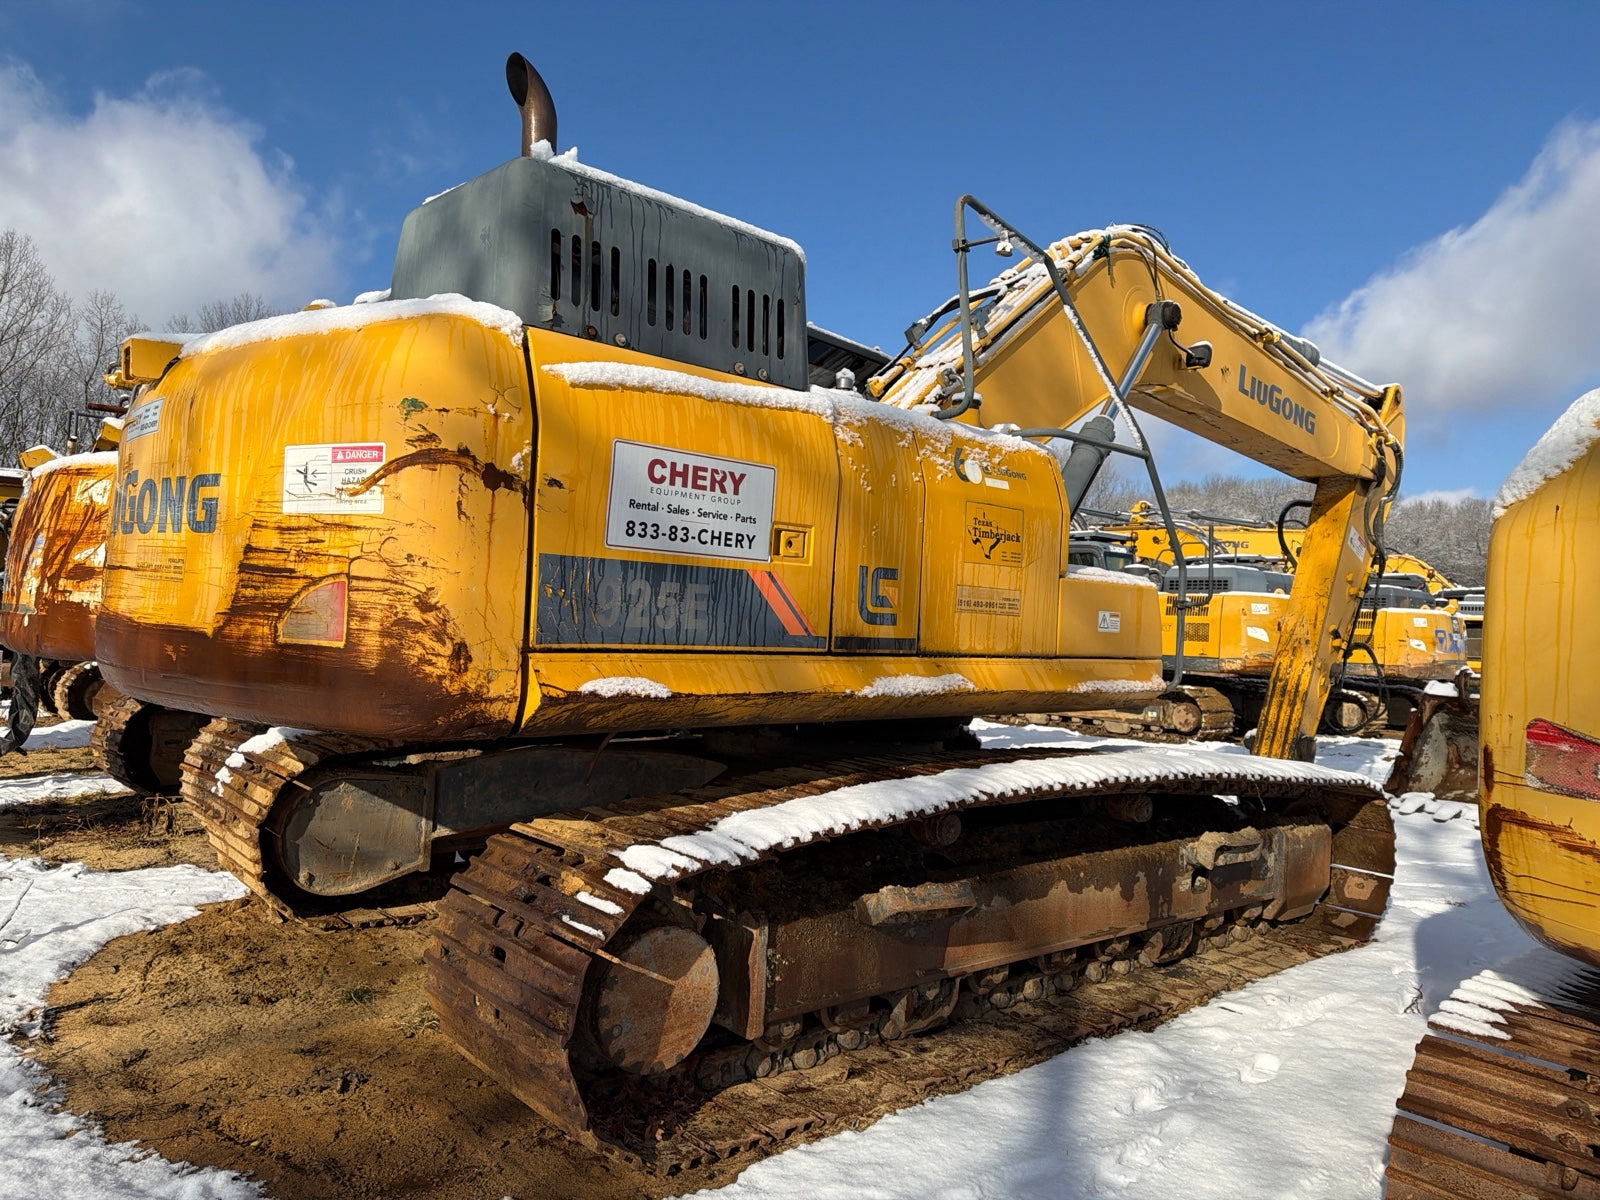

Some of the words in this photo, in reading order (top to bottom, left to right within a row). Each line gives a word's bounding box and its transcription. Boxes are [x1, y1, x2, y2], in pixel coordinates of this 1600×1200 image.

[345, 450, 379, 459] DANGER
[341, 476, 370, 485] HAZAR
[647, 458, 747, 496] CHERY
[650, 487, 706, 502] EQUIPMENT
[710, 495, 742, 506] GROUP
[629, 499, 659, 513] Rental
[667, 504, 690, 517] Sales
[697, 508, 728, 521] Service
[735, 513, 757, 525] Parts
[973, 517, 993, 527] Texas
[625, 520, 757, 550] 833-83-CHERY
[972, 527, 1021, 543] Timberjack
[597, 577, 710, 631] 925E
